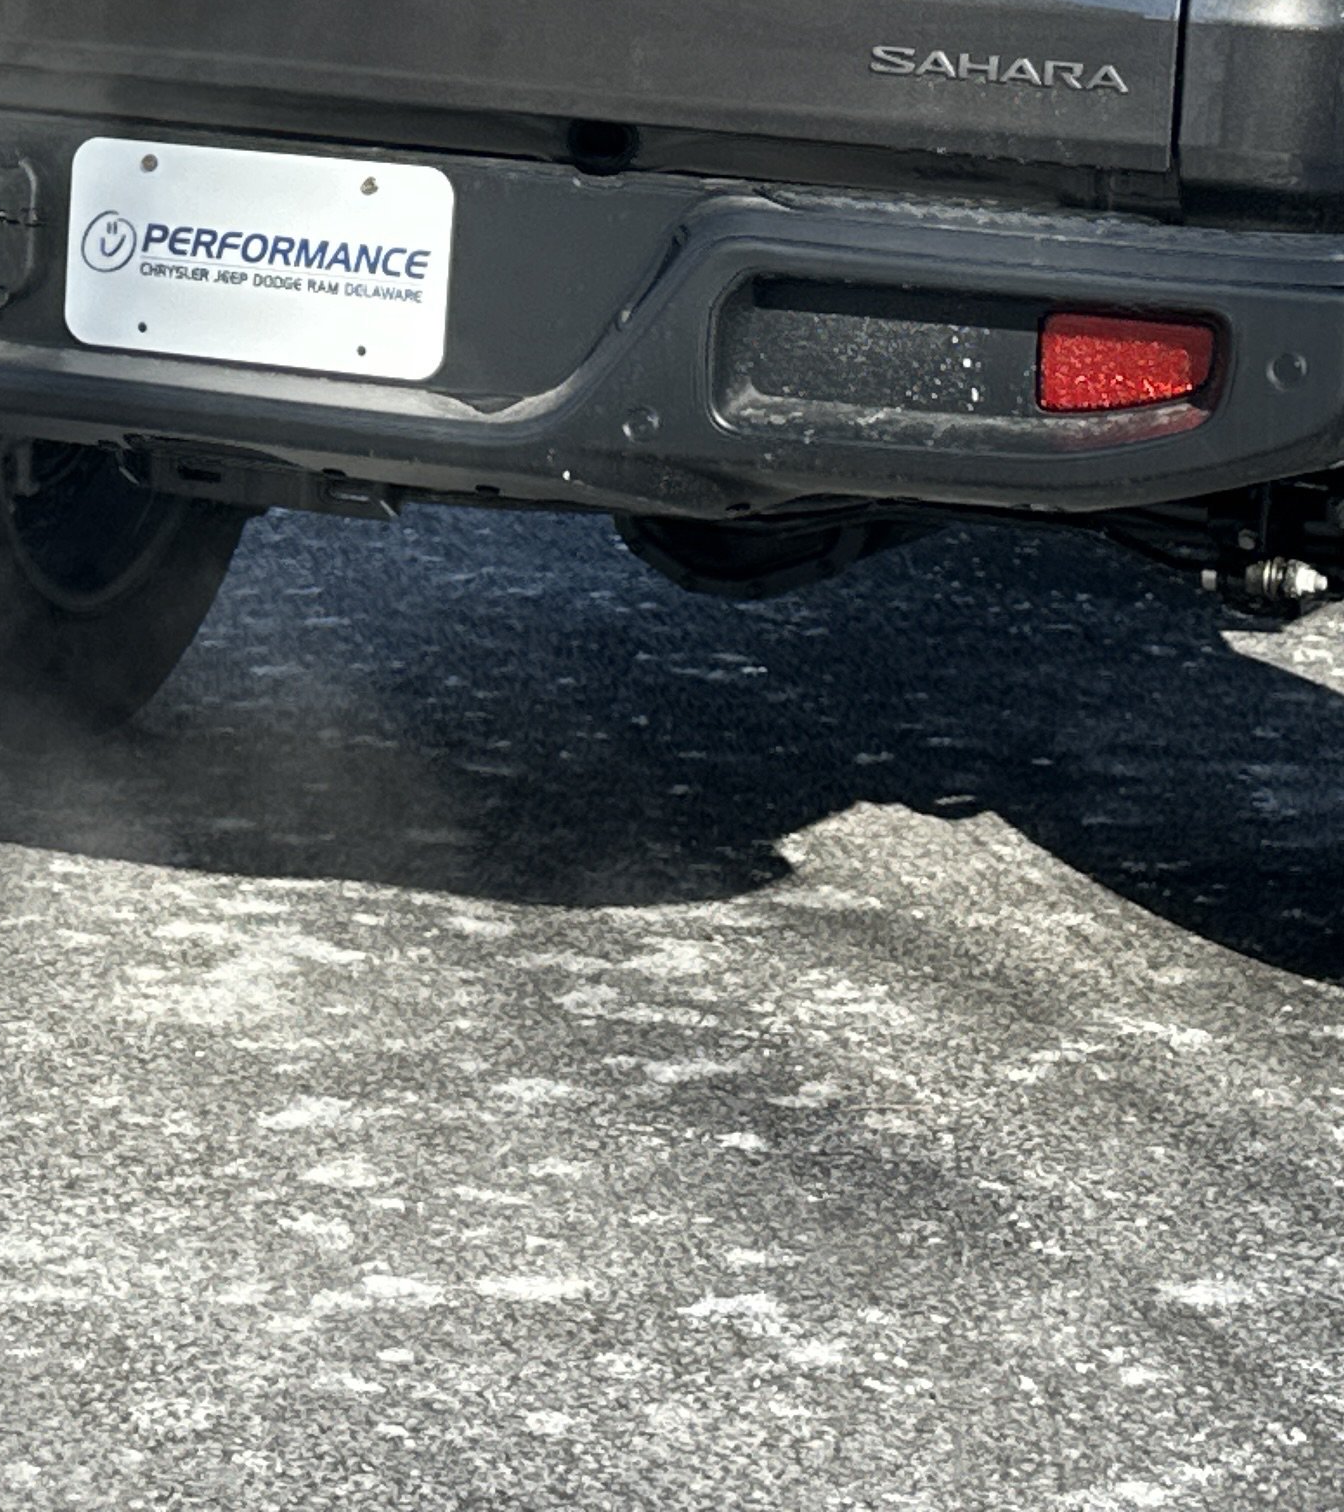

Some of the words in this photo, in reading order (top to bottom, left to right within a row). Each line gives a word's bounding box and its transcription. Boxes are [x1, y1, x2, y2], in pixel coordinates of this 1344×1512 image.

[870, 45, 1130, 94] SAHARA
[141, 223, 432, 279] PERFORMANCE
[140, 262, 210, 283] CHRYSLER
[213, 270, 248, 286] JEEP
[252, 273, 303, 292] DODGE
[307, 278, 339, 295] RAM
[344, 282, 423, 304] DELAWARE
